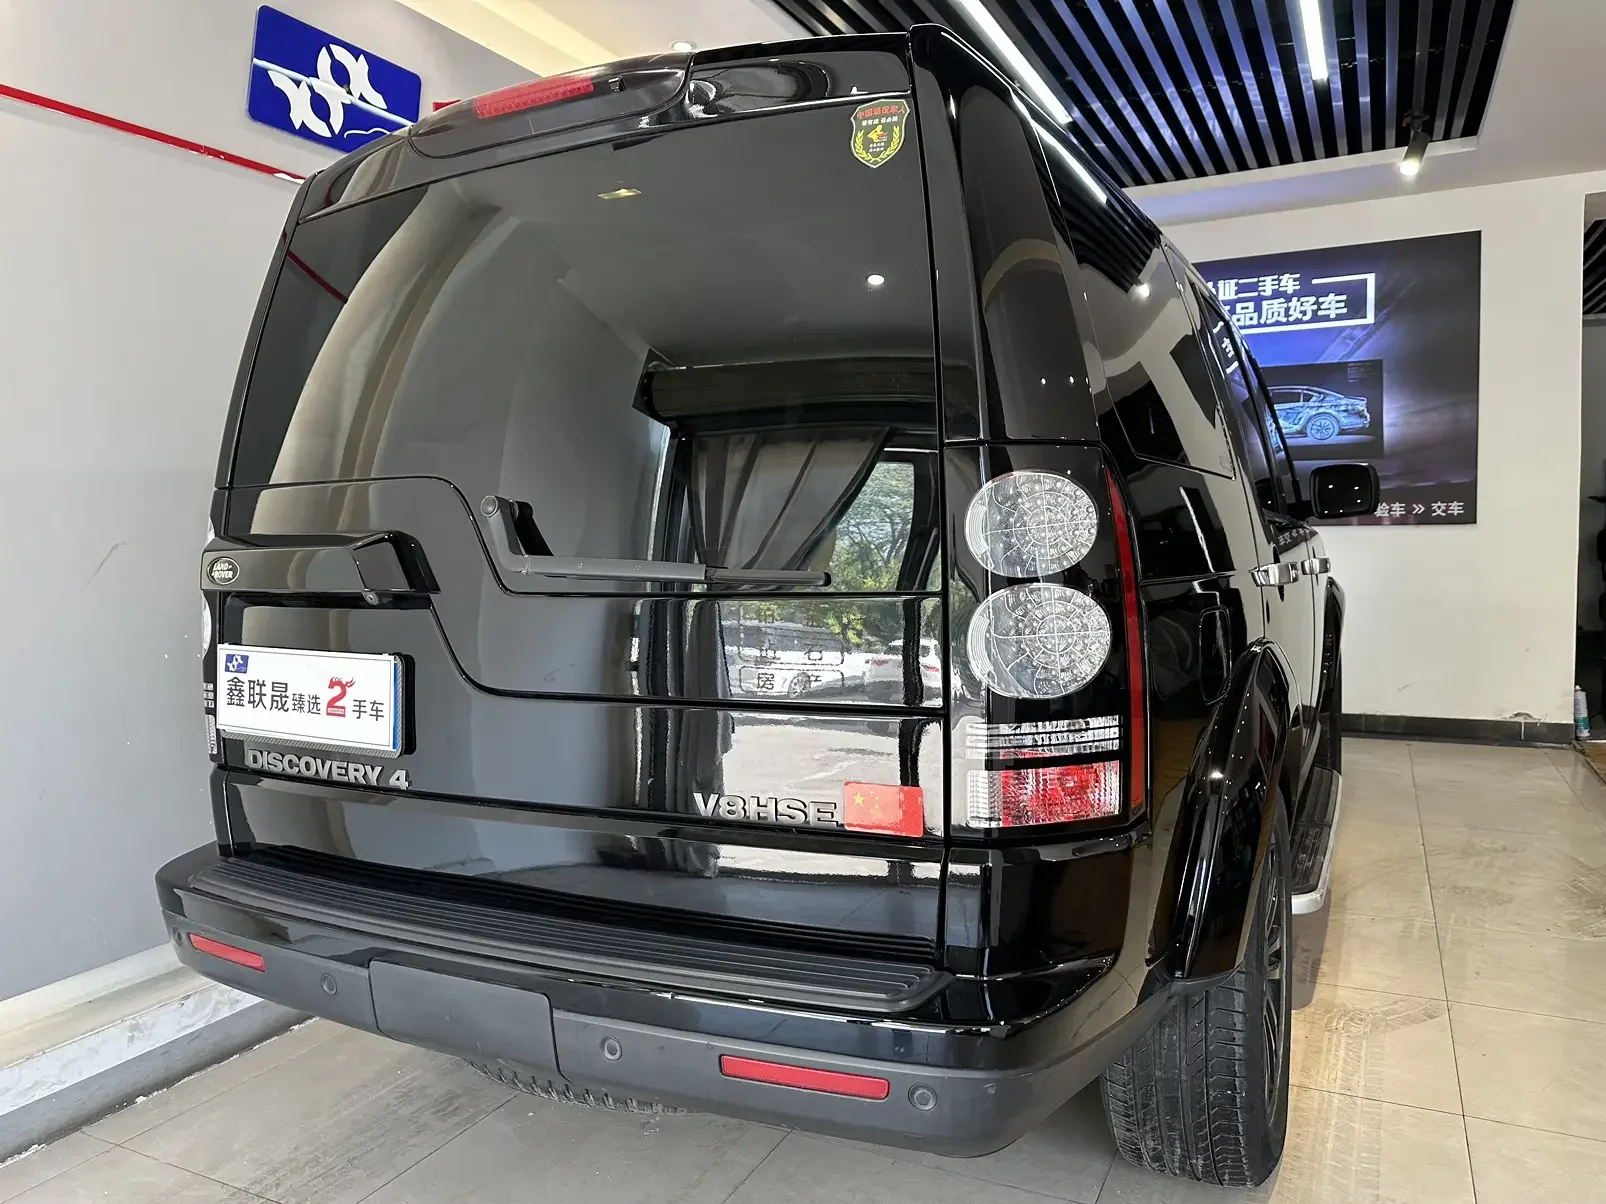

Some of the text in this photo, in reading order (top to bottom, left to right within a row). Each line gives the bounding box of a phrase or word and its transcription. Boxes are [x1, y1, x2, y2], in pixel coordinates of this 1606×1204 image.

[1225, 293, 1347, 326] 品质好车
[1431, 501, 1464, 516] 交车
[247, 749, 412, 790] DISCOVERY 4
